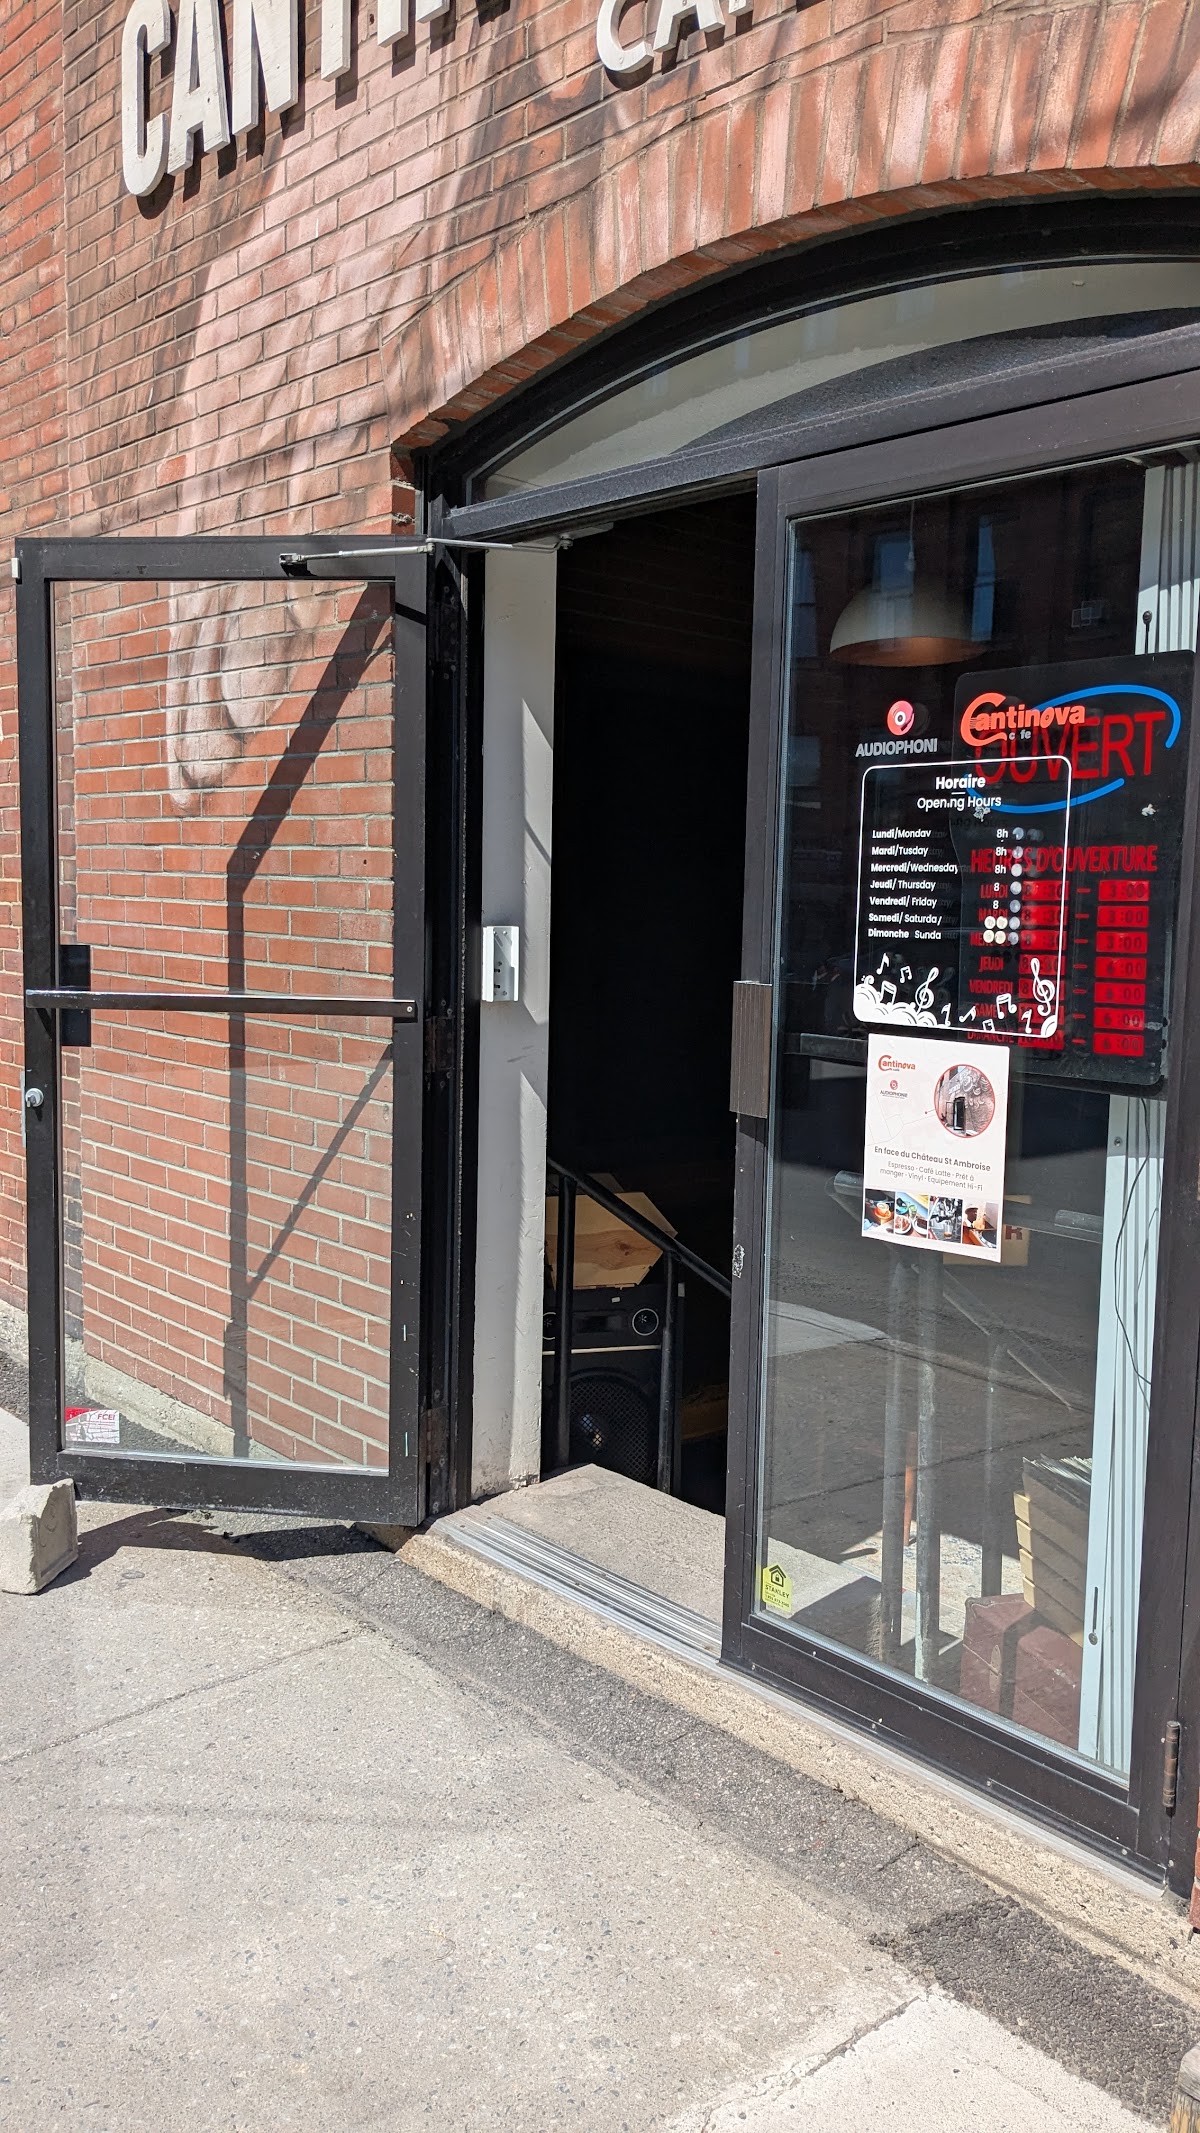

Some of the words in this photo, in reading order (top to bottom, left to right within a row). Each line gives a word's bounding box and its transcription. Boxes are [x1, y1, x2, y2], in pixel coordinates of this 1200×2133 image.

[960, 692, 1086, 747] Cantinova
[935, 773, 986, 790] Horaire
[917, 797, 965, 812] Openng
[967, 796, 1002, 809] Hours
[996, 828, 1009, 838] 8h
[995, 846, 1007, 856] 8h
[994, 864, 1006, 874] 8h
[898, 880, 936, 892] Thursday
[911, 897, 937, 909] Friday
[969, 979, 1014, 994] VENDREDI
[878, 1055, 916, 1071] Cantinova
[874, 1146, 882, 1154] En
[884, 1147, 900, 1157] face
[911, 1152, 943, 1164] Château
[944, 1157, 952, 1165] St
[953, 1159, 991, 1171] Ambroise
[887, 1161, 915, 1171] Espresso
